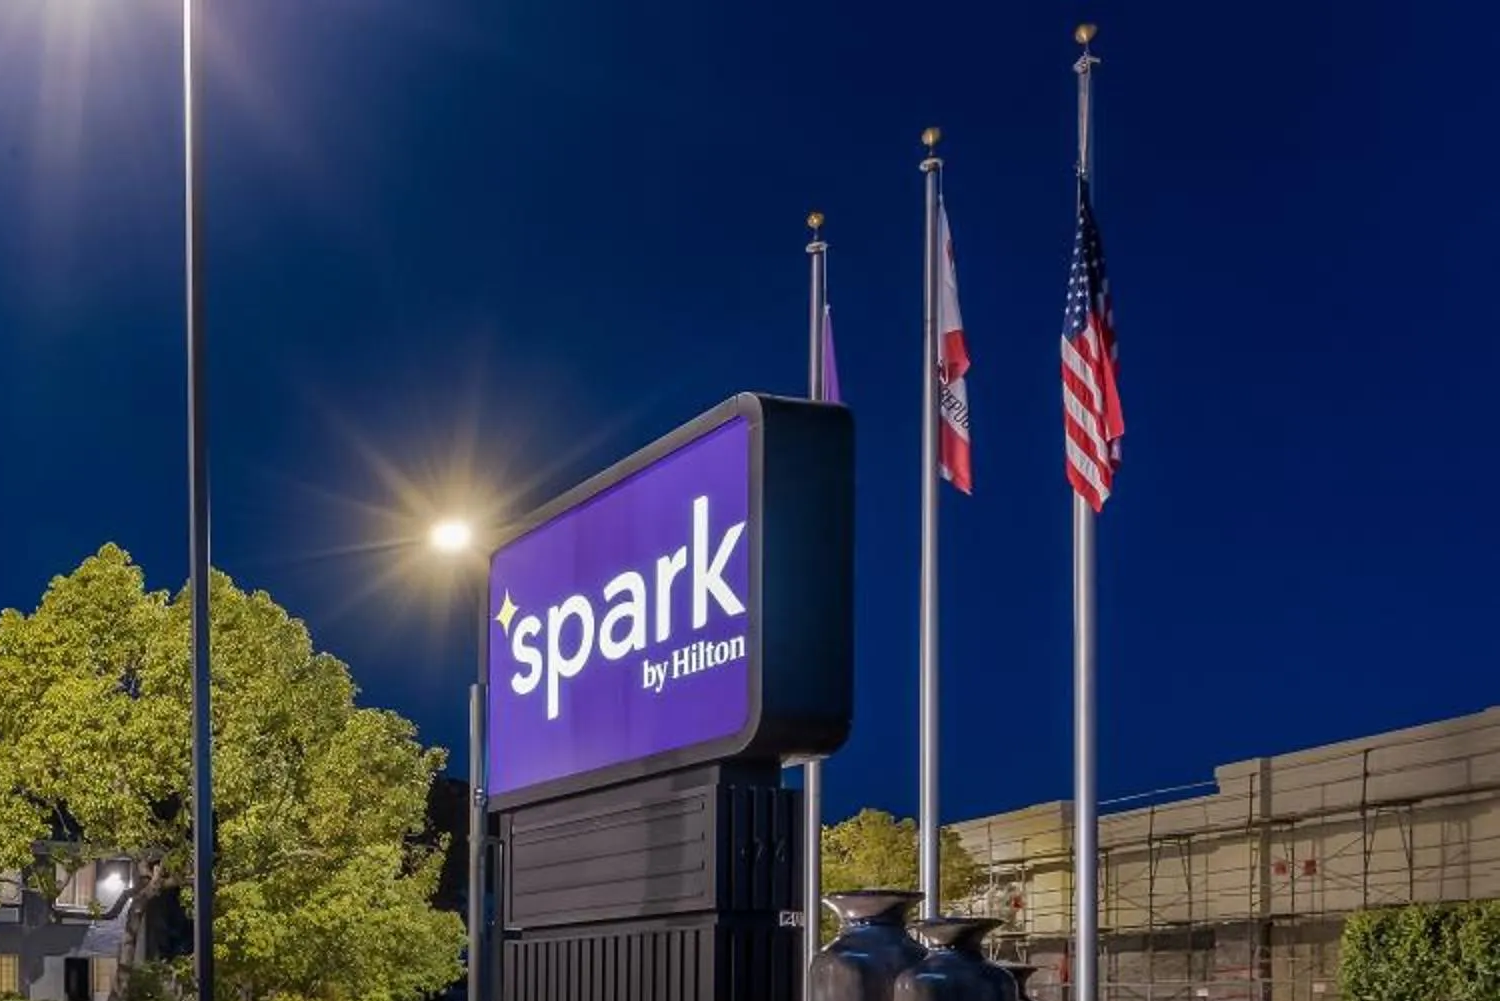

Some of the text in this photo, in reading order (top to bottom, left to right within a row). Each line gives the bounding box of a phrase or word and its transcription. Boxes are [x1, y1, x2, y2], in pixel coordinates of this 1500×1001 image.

[510, 494, 747, 721] spark
[642, 635, 746, 694] by Hilton
